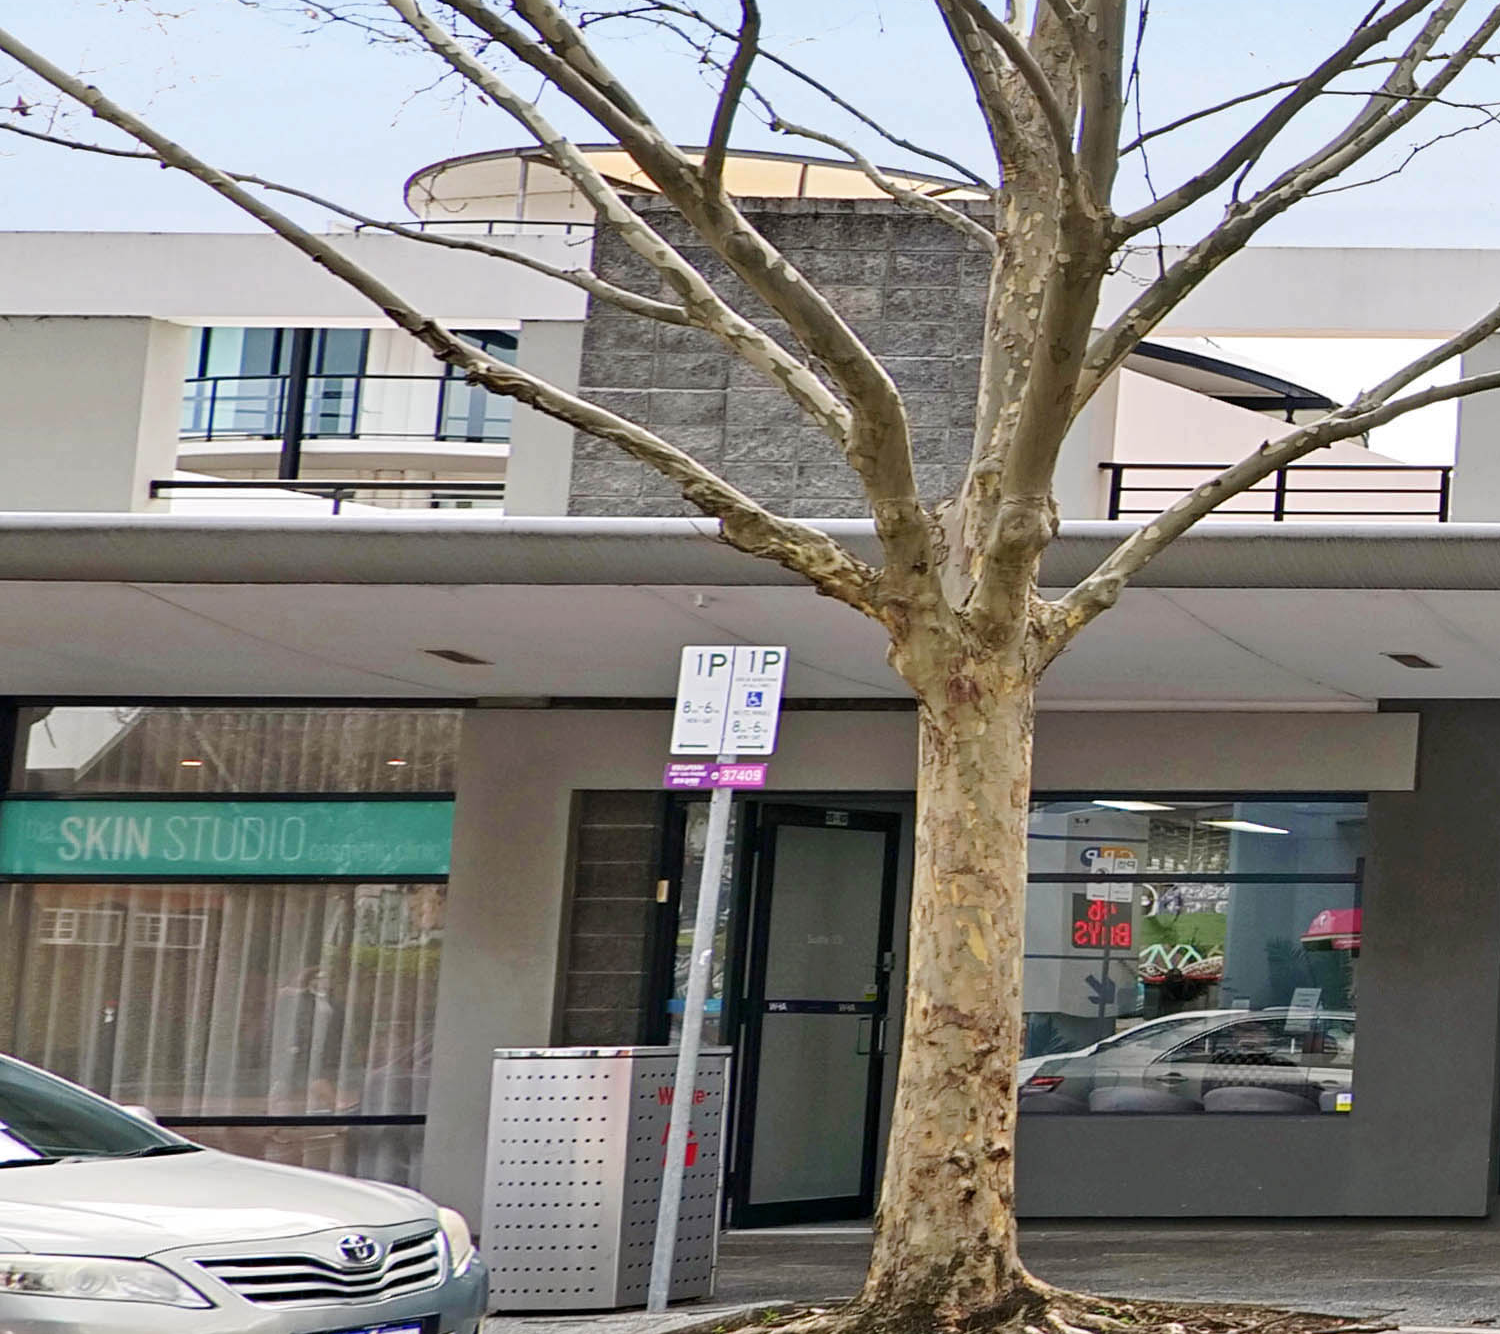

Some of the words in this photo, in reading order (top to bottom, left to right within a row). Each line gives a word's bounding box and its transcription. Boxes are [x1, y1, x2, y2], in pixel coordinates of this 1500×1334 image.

[697, 653, 727, 677] 1P
[750, 650, 781, 674] 1P
[720, 769, 763, 781] 37409
[58, 816, 151, 861] SKIN
[163, 816, 306, 861] STUDIO
